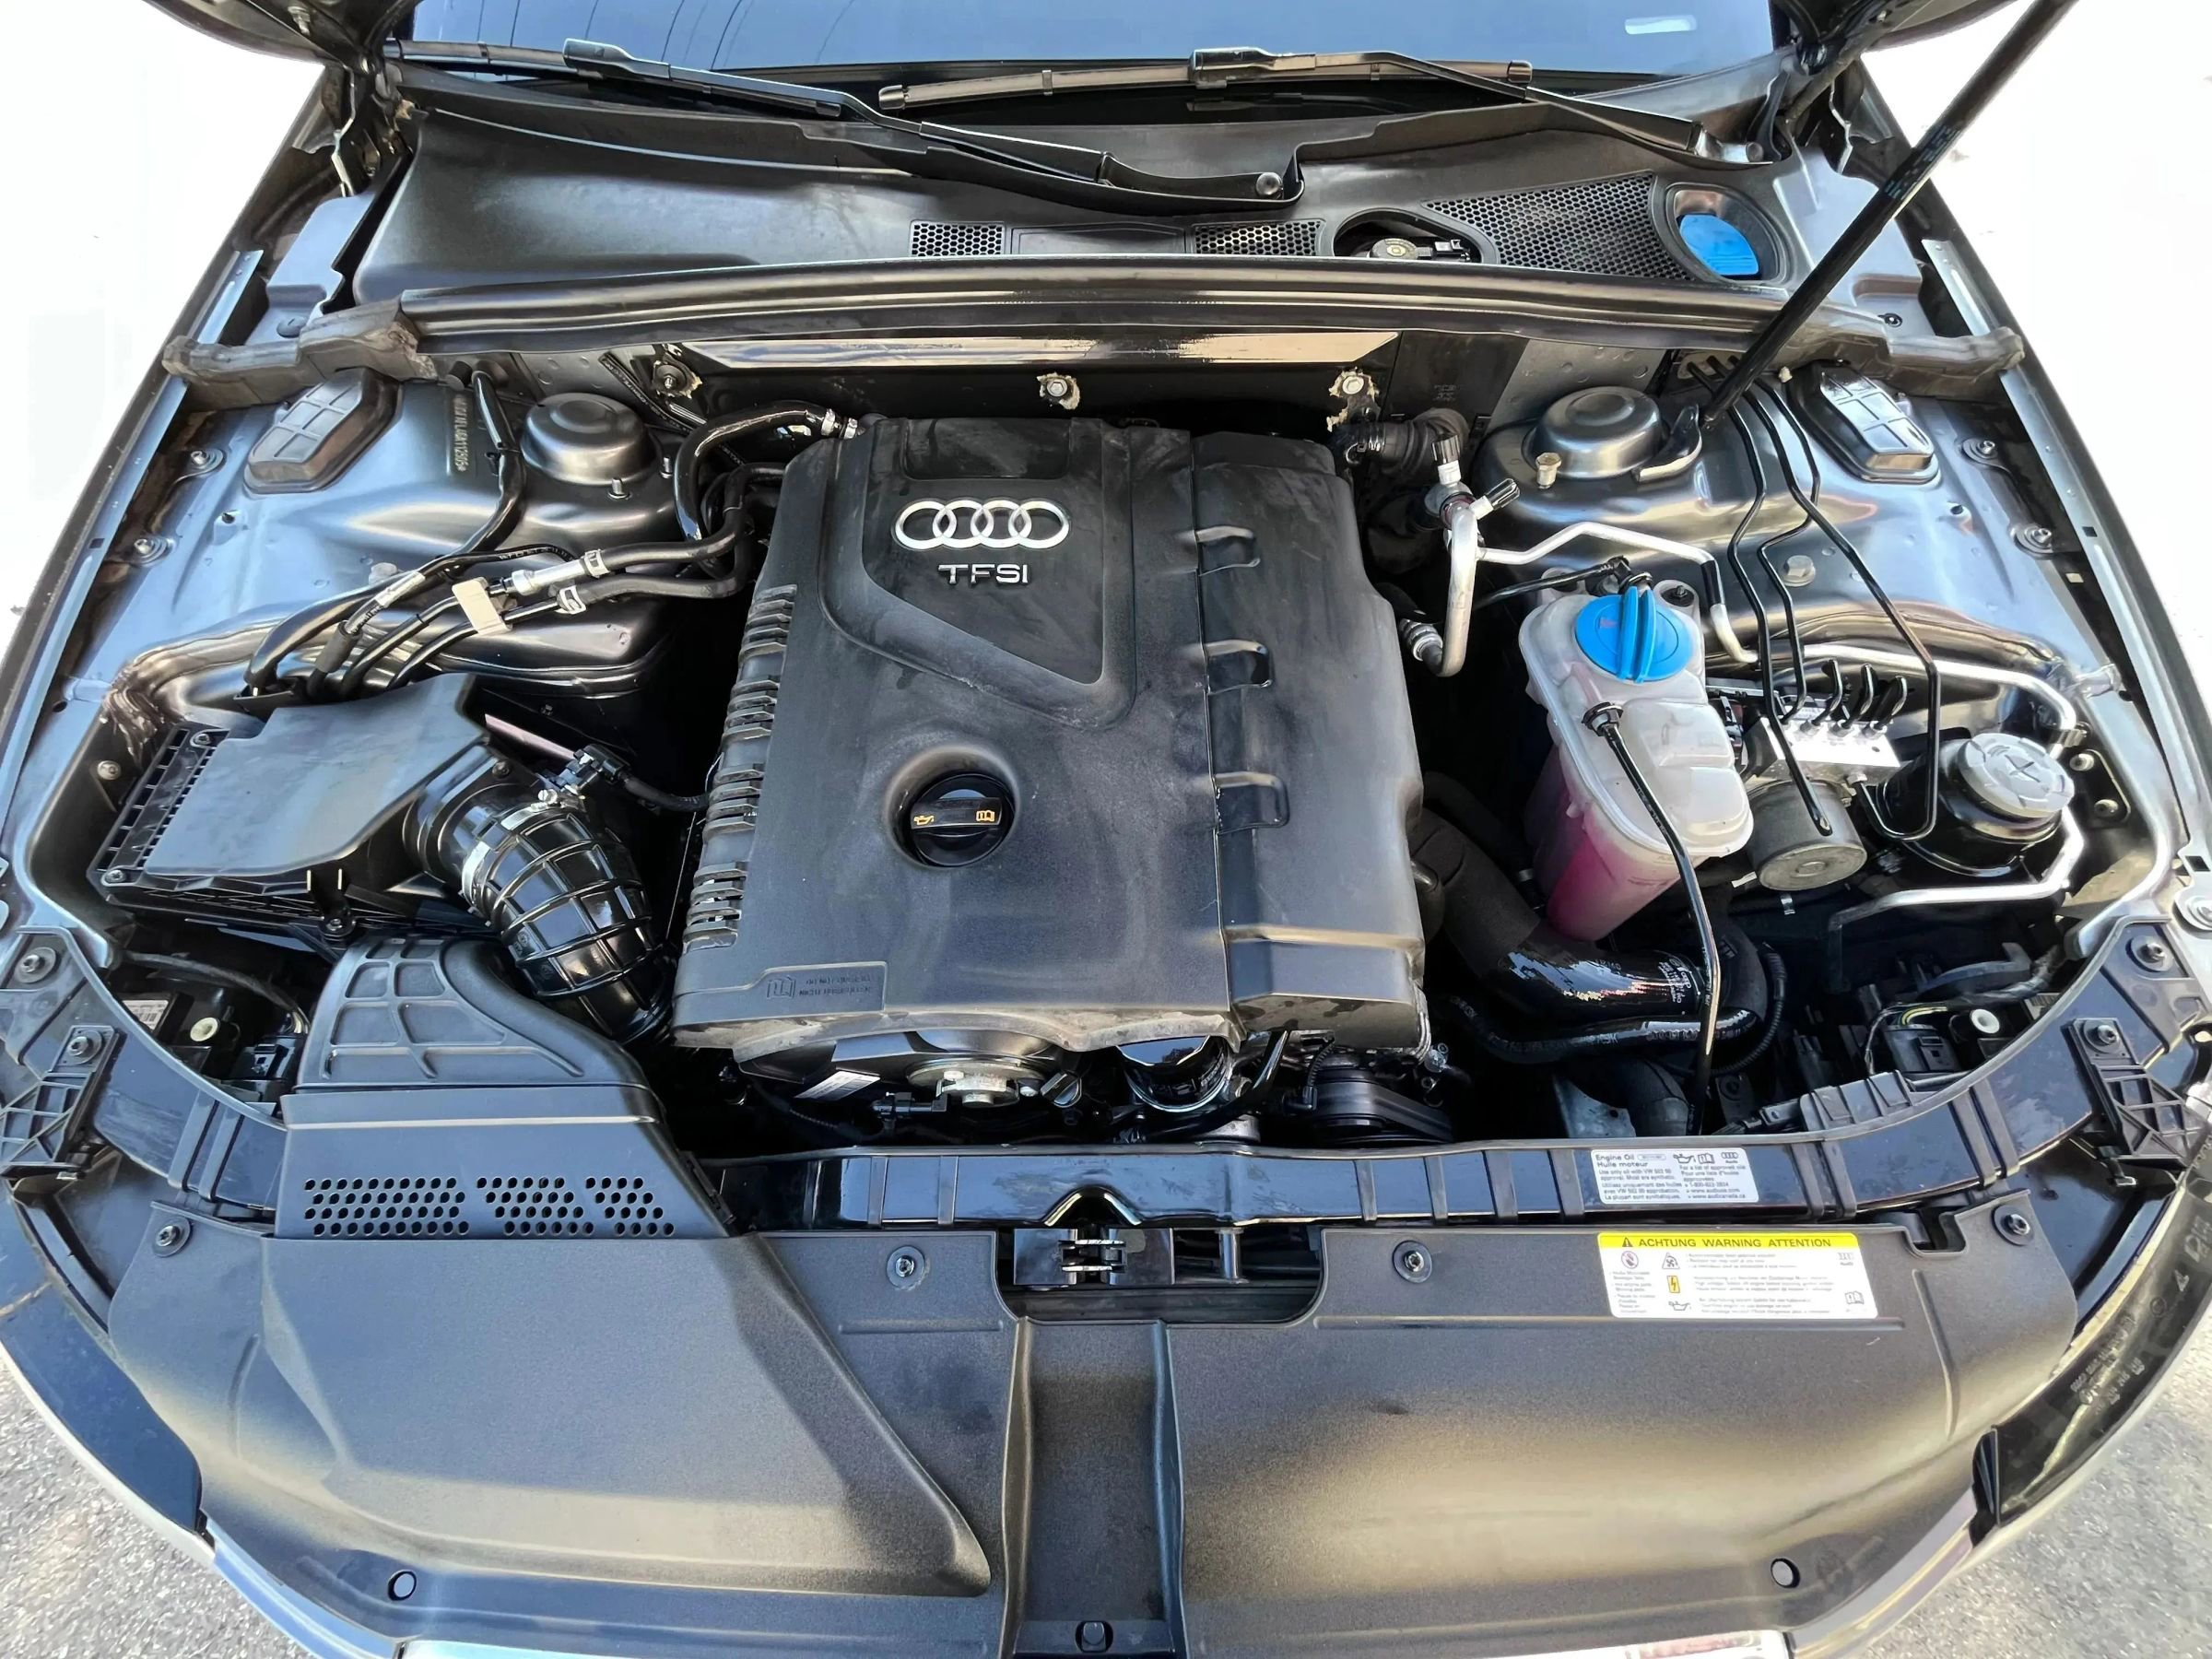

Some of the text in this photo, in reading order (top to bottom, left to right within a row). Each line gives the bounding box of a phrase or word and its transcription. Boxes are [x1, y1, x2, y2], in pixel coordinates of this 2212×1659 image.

[937, 563, 1029, 584] TFSI
[1639, 1239, 1831, 1248] ACHTUNG WARNING ATTENTION
